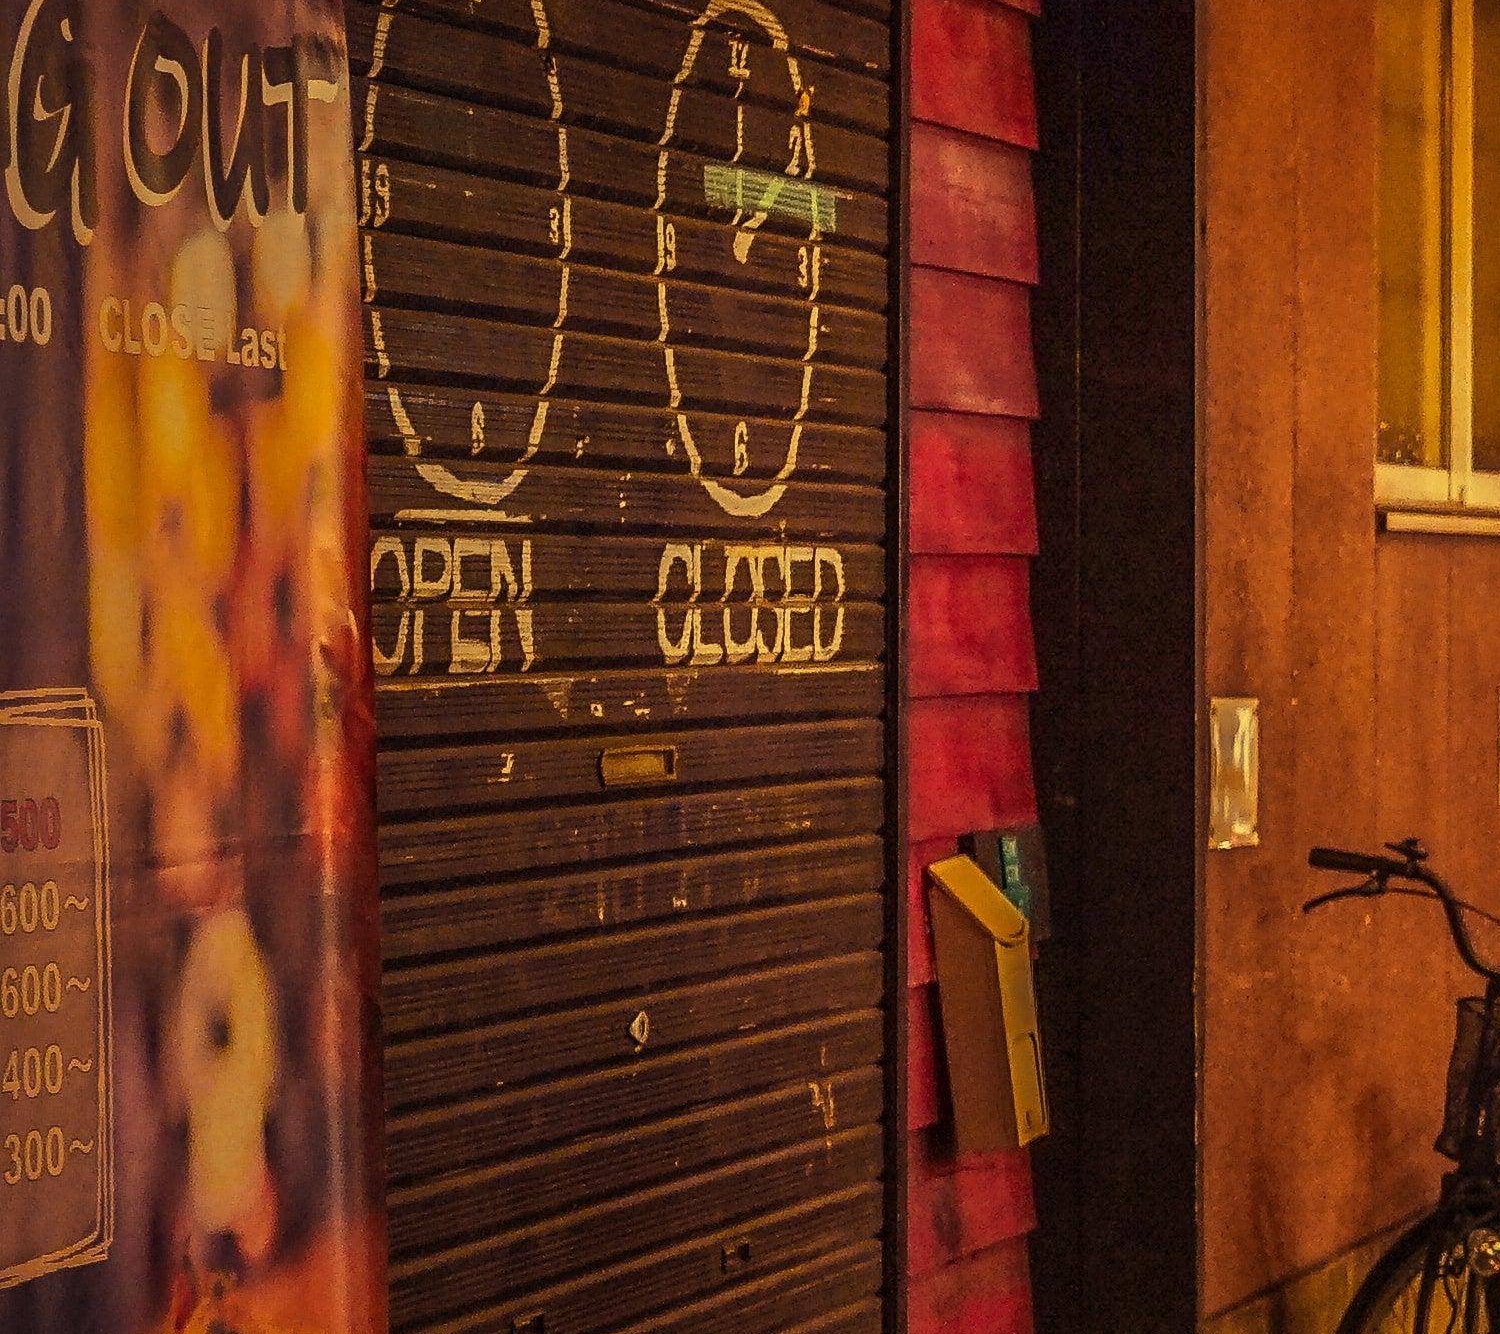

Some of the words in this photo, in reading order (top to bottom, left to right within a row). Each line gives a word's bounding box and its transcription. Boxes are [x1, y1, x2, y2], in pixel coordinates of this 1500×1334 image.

[100, 296, 217, 362] CLOSE
[227, 323, 288, 372] Last
[371, 535, 534, 674] OPEN
[656, 541, 847, 668] CLOSED
